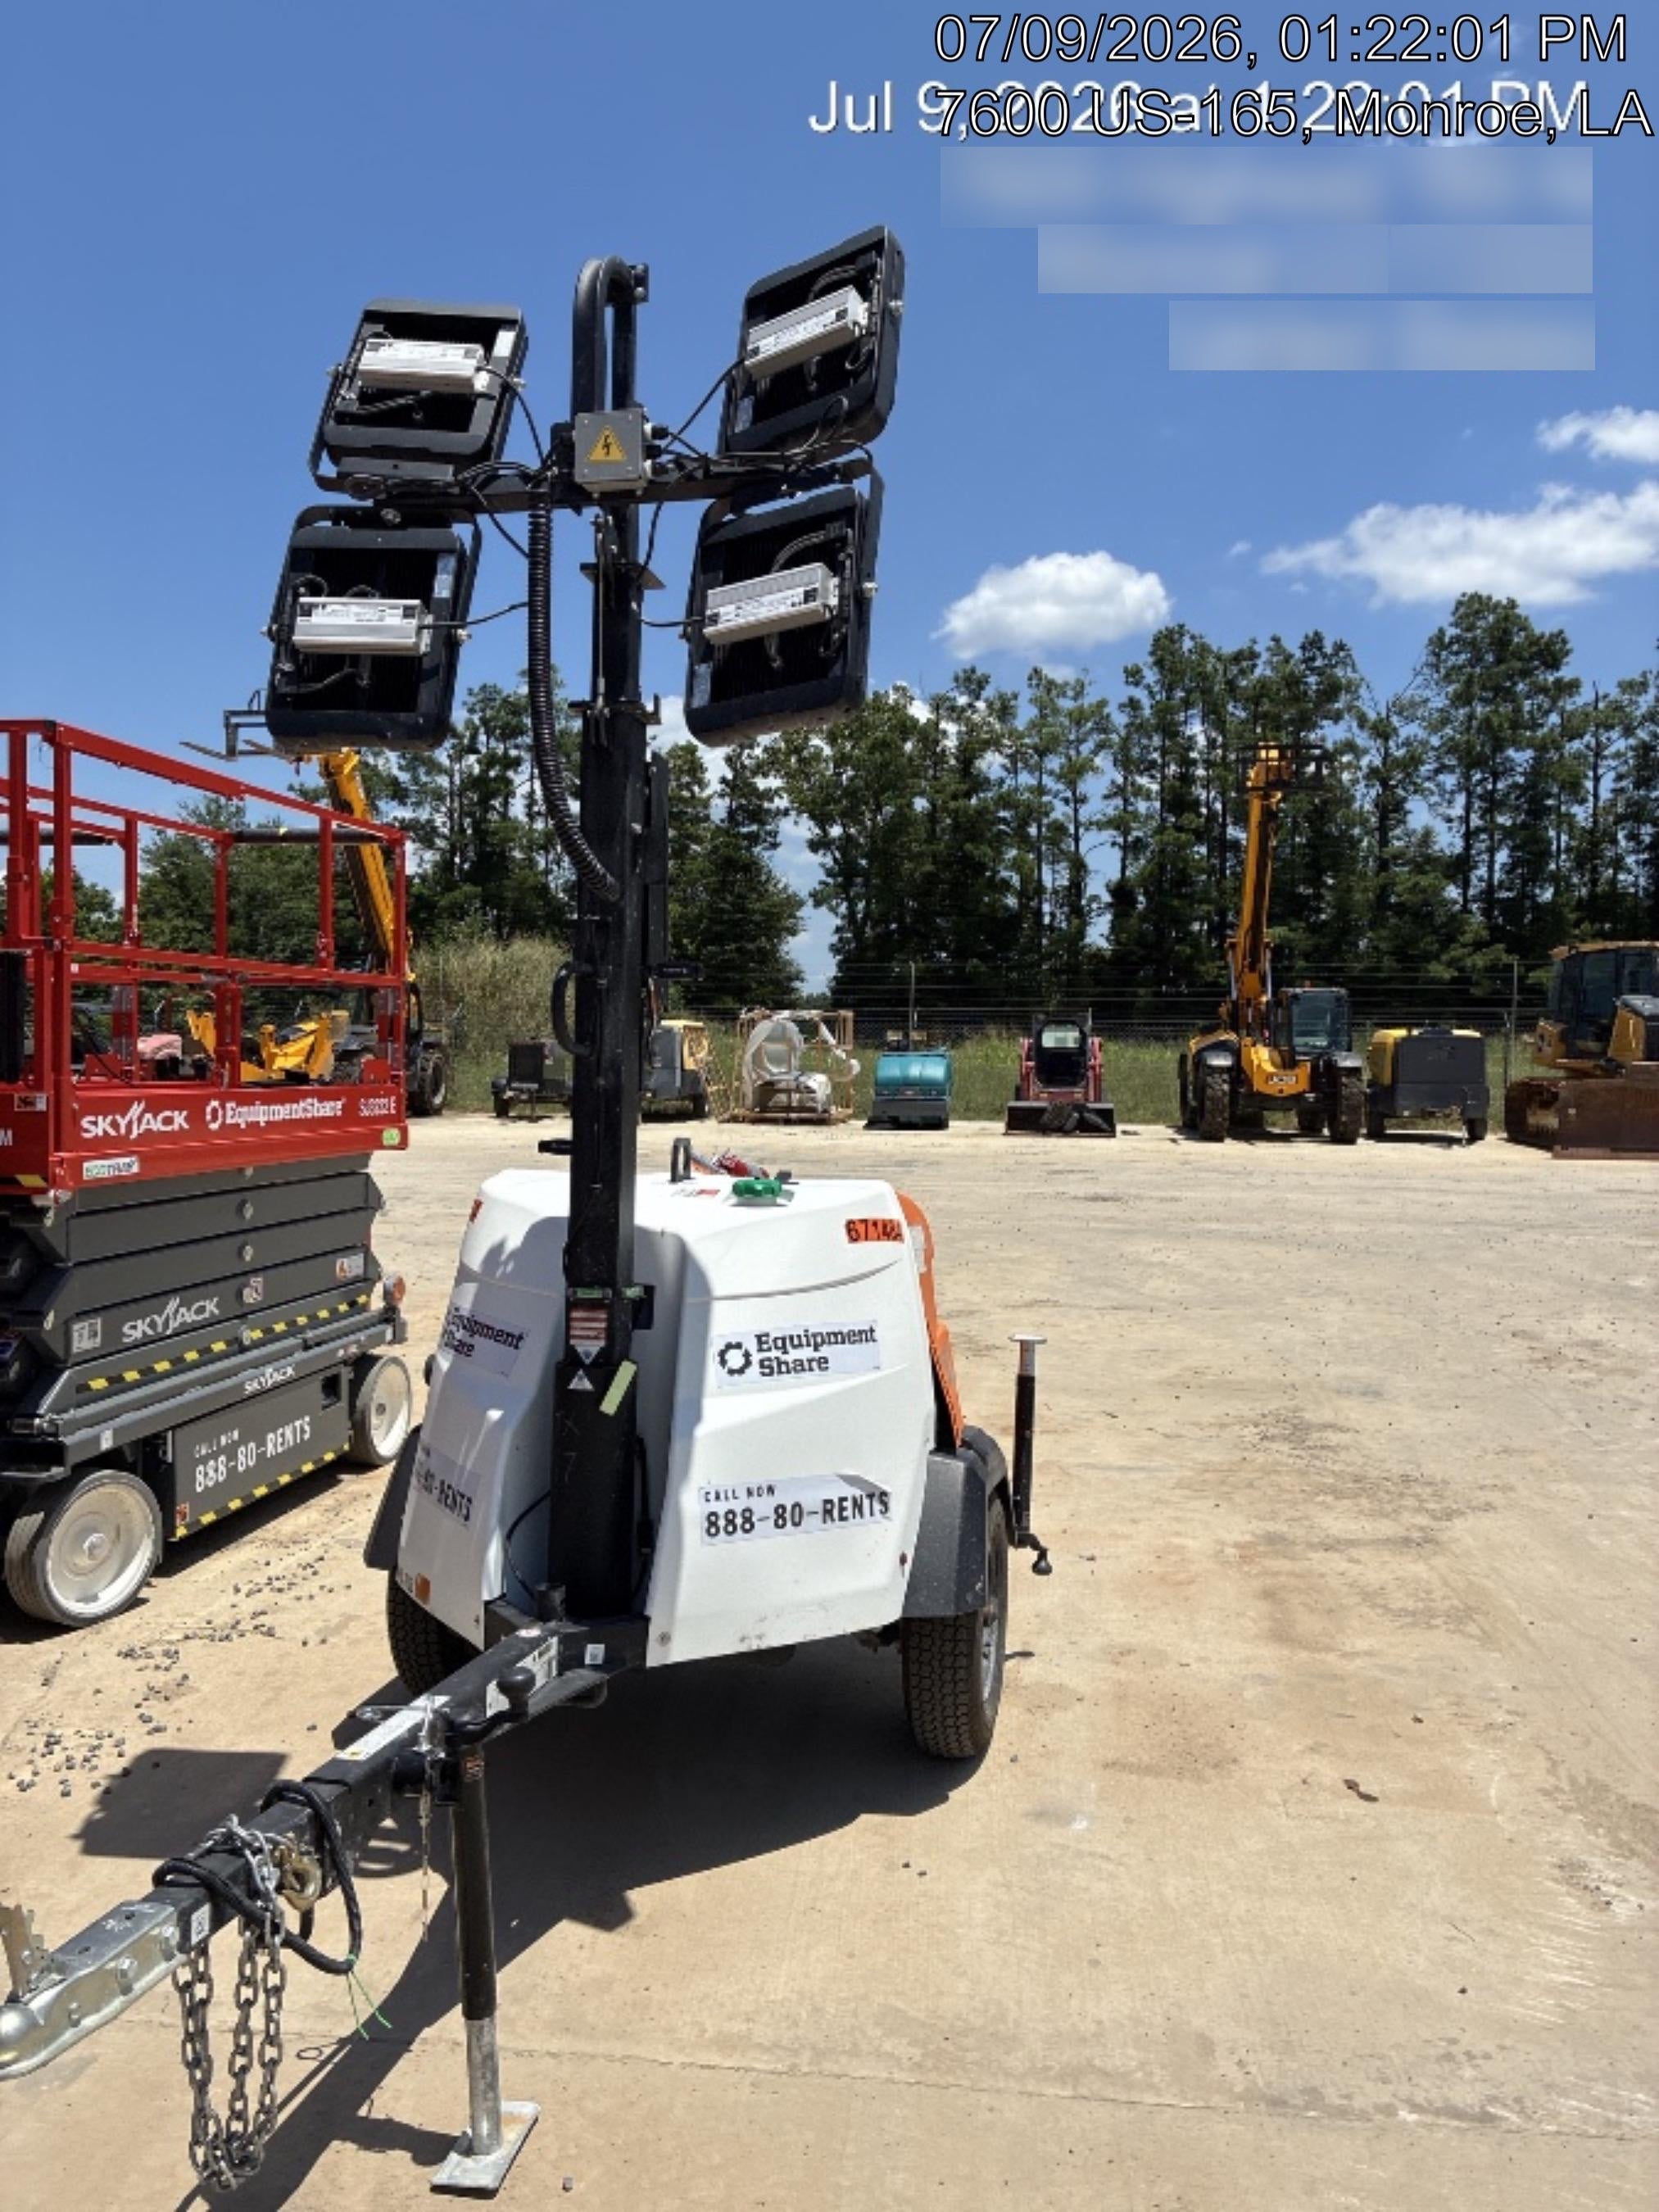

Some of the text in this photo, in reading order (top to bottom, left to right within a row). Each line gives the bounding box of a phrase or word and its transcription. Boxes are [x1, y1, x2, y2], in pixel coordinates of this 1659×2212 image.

[80, 1099, 190, 1140] SKYJACK
[224, 1095, 342, 1130] EquipmentShare
[122, 1296, 220, 1344] SKYJACK
[754, 1324, 877, 1355] Equipment
[244, 1363, 296, 1394] SKYJACK
[758, 1356, 829, 1377] Share
[195, 1415, 310, 1493] 888-80-RENTS
[705, 1484, 775, 1503] CALL NOW
[705, 1490, 891, 1538] 888-80-RENTS
